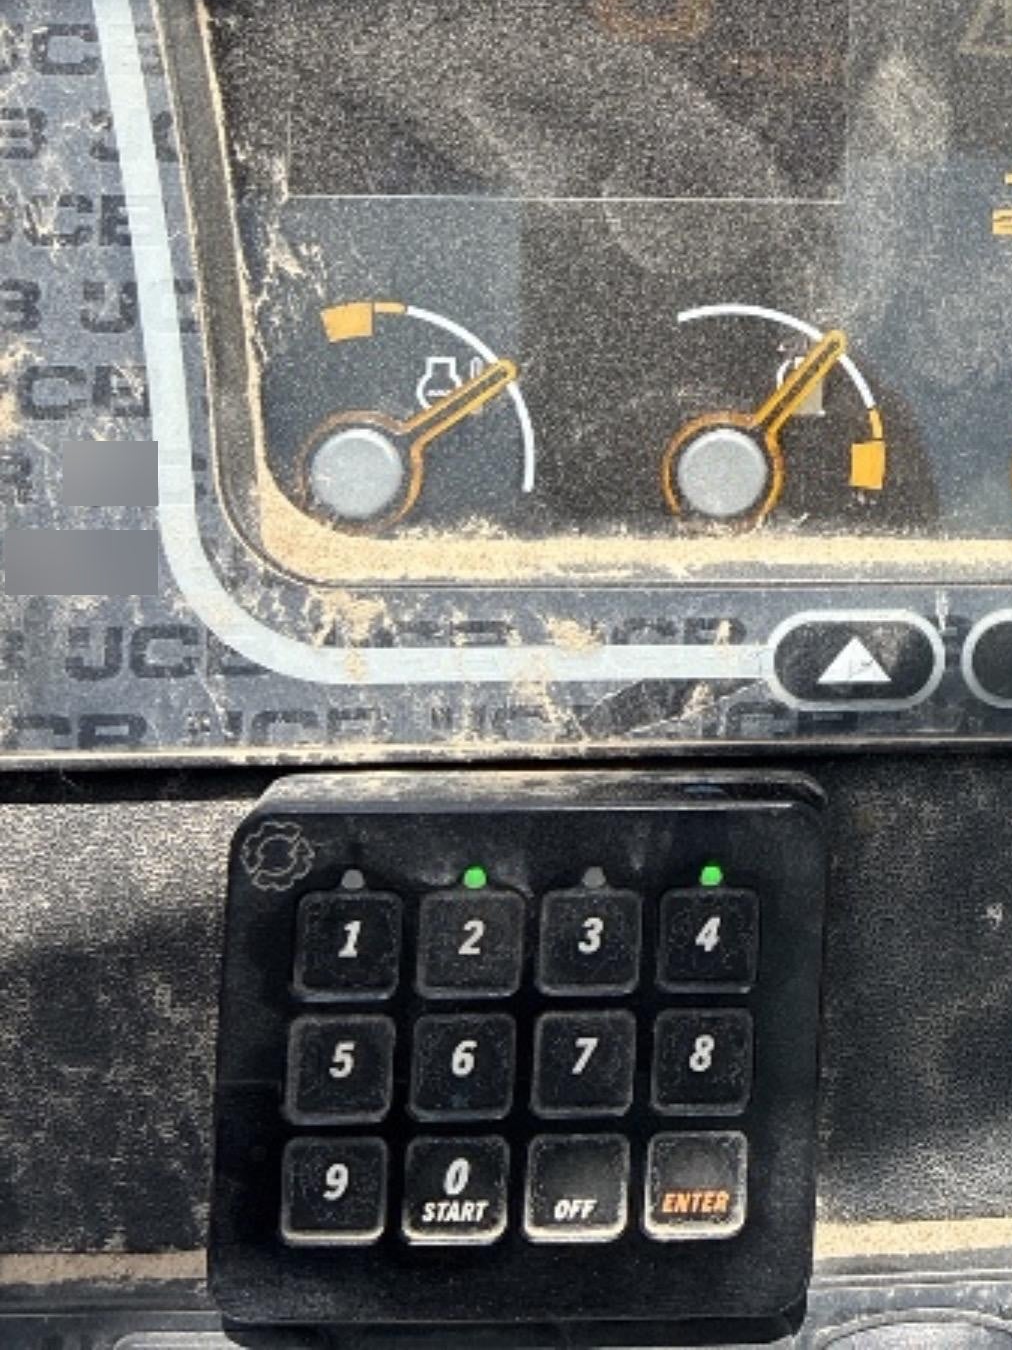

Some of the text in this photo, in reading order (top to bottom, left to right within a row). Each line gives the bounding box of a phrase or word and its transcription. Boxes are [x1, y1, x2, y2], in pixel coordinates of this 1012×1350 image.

[338, 922, 362, 958] 1
[458, 920, 484, 956] 2
[578, 916, 604, 953] 3
[696, 916, 720, 951] 4
[329, 1042, 355, 1078] 5
[451, 1040, 477, 1076] 6
[572, 1038, 598, 1074] 7
[688, 1036, 715, 1071] 8
[324, 1164, 348, 1200] 9
[444, 1158, 470, 1194] 0
[421, 1199, 488, 1223] START
[554, 1199, 596, 1220] OFF
[661, 1190, 730, 1213] ENTER
